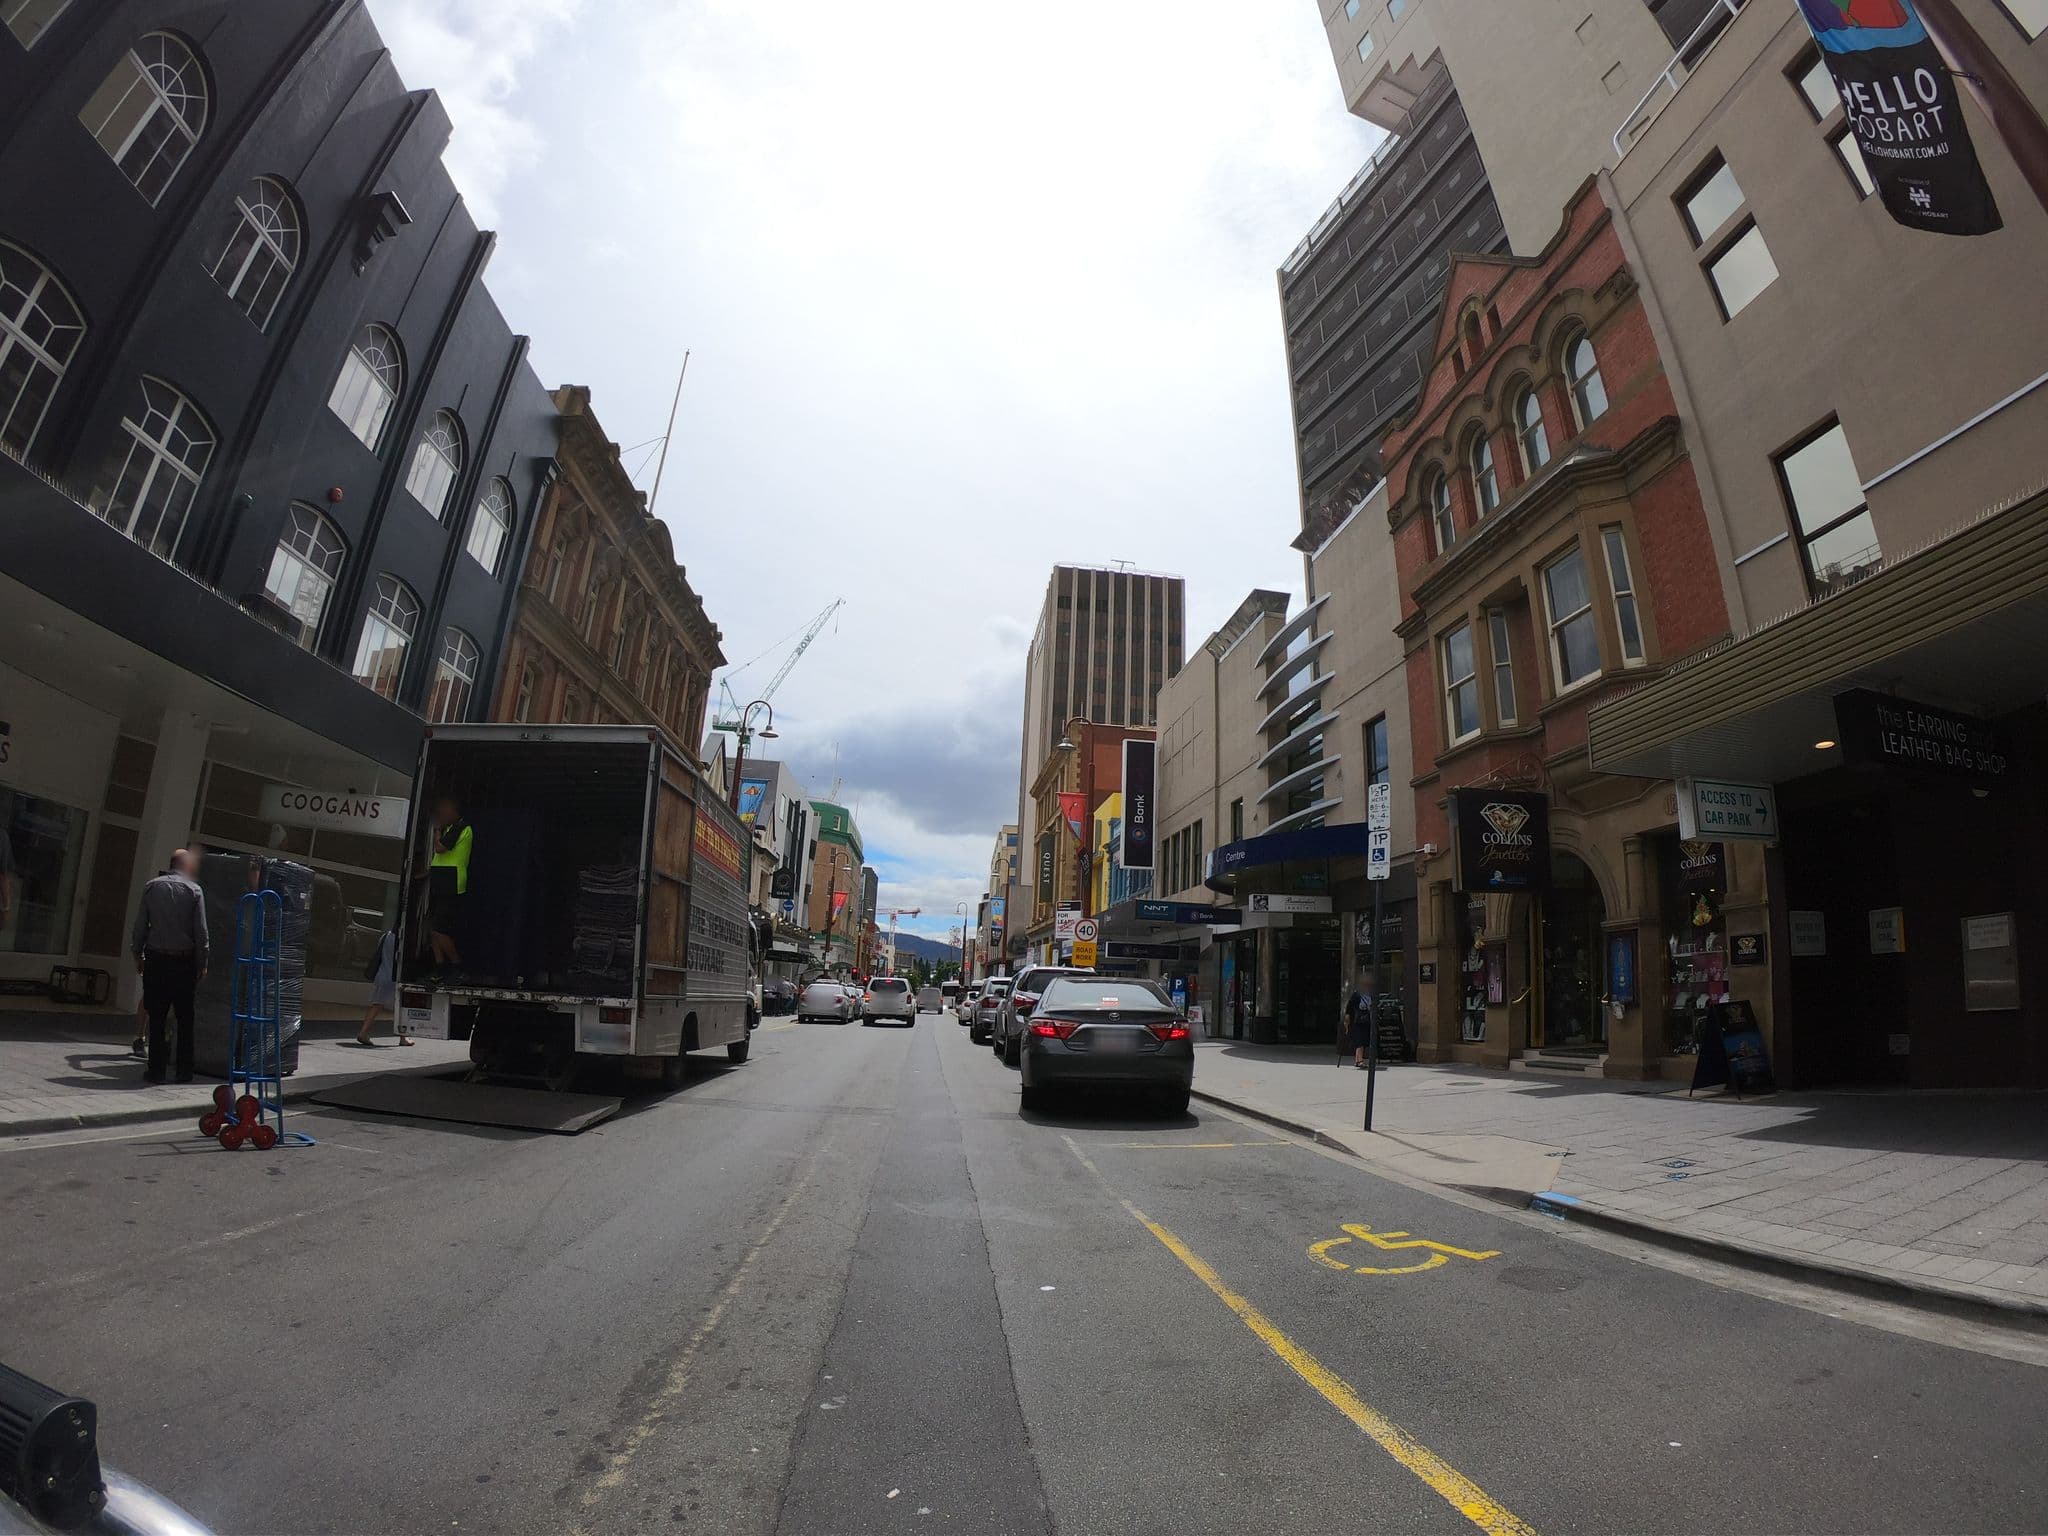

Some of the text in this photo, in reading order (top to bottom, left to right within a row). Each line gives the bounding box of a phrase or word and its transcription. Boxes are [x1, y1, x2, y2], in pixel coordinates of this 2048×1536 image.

[1907, 710, 1967, 744] EARRING
[1881, 730, 2008, 774] LEATHER BAG SHOP
[281, 792, 380, 818] COOGANS
[1700, 790, 1752, 807] ACCESS TO
[1134, 794, 1145, 824] Bank
[1705, 810, 1752, 827] CAR PARK
[1374, 833, 1388, 845] 1P
[1482, 832, 1533, 847] COLLINS
[1225, 849, 1246, 862] Centre
[1680, 853, 1717, 870] COLLINS
[1043, 851, 1051, 884] QUEST
[1143, 904, 1169, 912] NNT
[1079, 925, 1094, 936] 40
[1075, 953, 1093, 961] WORK
[1076, 946, 1093, 954] ROAD
[1175, 979, 1182, 989] P
